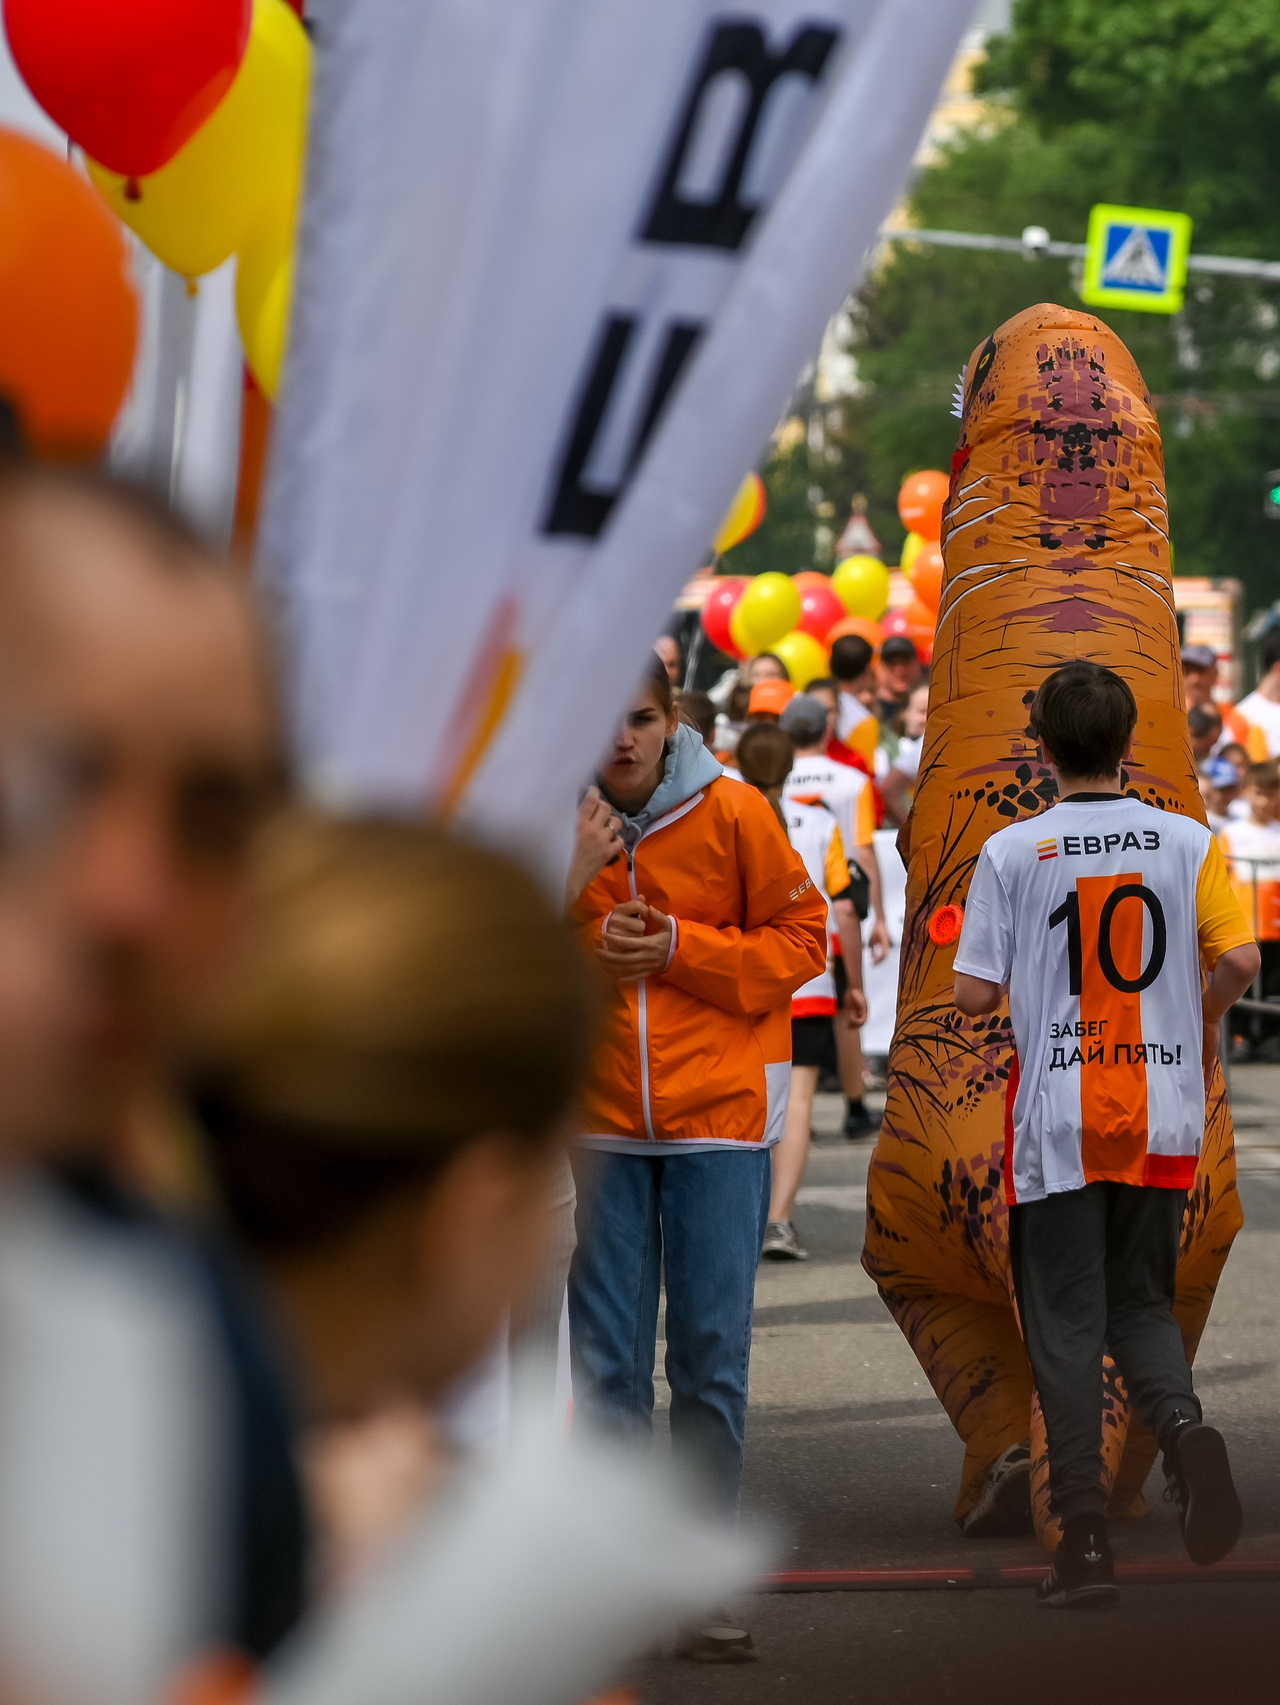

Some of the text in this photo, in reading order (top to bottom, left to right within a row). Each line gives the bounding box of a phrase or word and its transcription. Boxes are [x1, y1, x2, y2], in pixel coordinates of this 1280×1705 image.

[1063, 830, 1160, 855] ЕВРАЗ
[1048, 883, 1167, 996] 10
[1049, 1020, 1108, 1039] ЗАБЕГ
[1050, 1040, 1182, 1072] ДАЙ ПЯТЬ!
